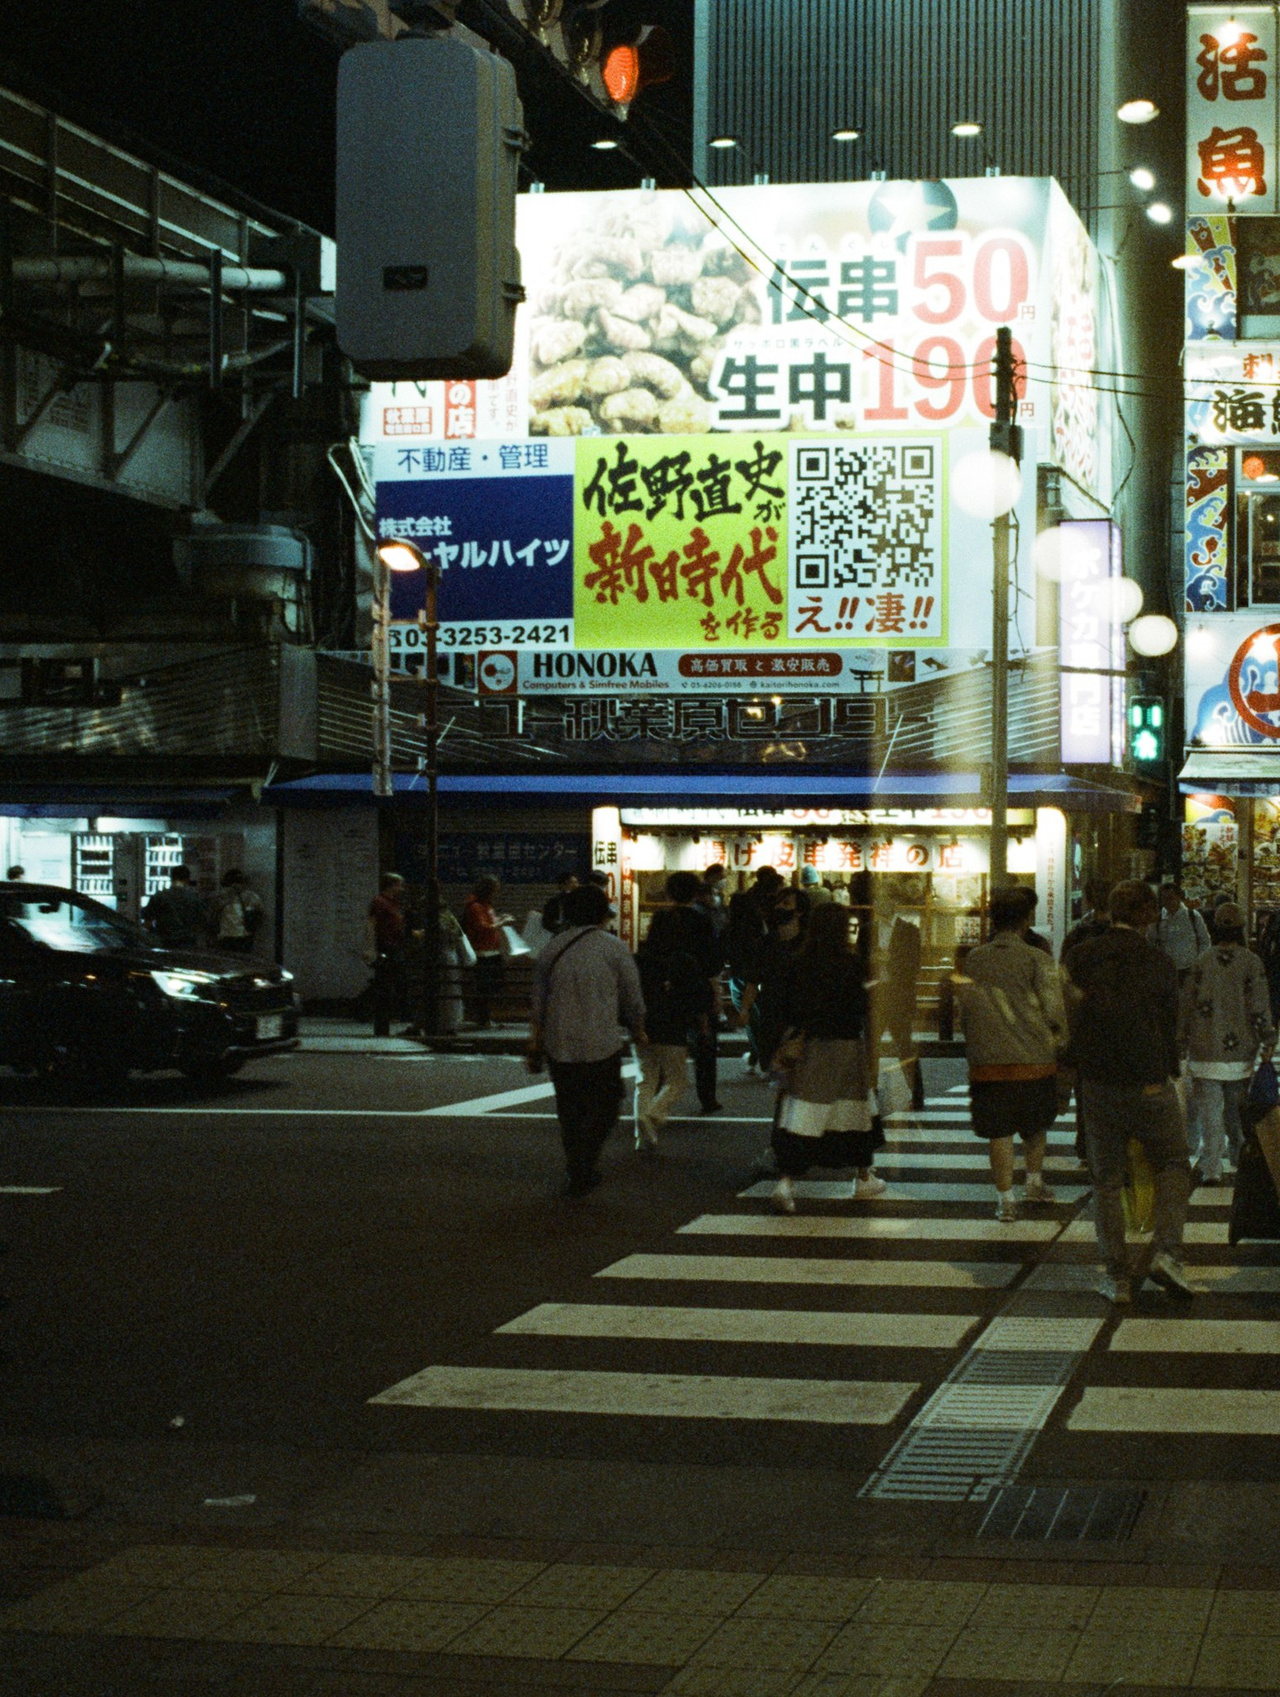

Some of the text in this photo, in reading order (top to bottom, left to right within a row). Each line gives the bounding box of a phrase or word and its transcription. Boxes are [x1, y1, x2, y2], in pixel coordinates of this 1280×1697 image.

[1197, 30, 1267, 197] 活魚
[766, 254, 899, 326] 伝串
[718, 352, 851, 421] 生中
[398, 441, 549, 474] 不動産・管理
[379, 516, 452, 538] 株式会社
[584, 521, 784, 606] 新時代
[404, 625, 570, 648] 03-3253-2421
[700, 607, 784, 642] を作る
[533, 652, 658, 678] HONOKA
[690, 657, 831, 674] 高価買取 と 激安販売
[522, 678, 670, 691] Computers & Simfree Mobiles
[760, 680, 840, 690] kaitorihonoka.com
[594, 840, 618, 867] 伝串
